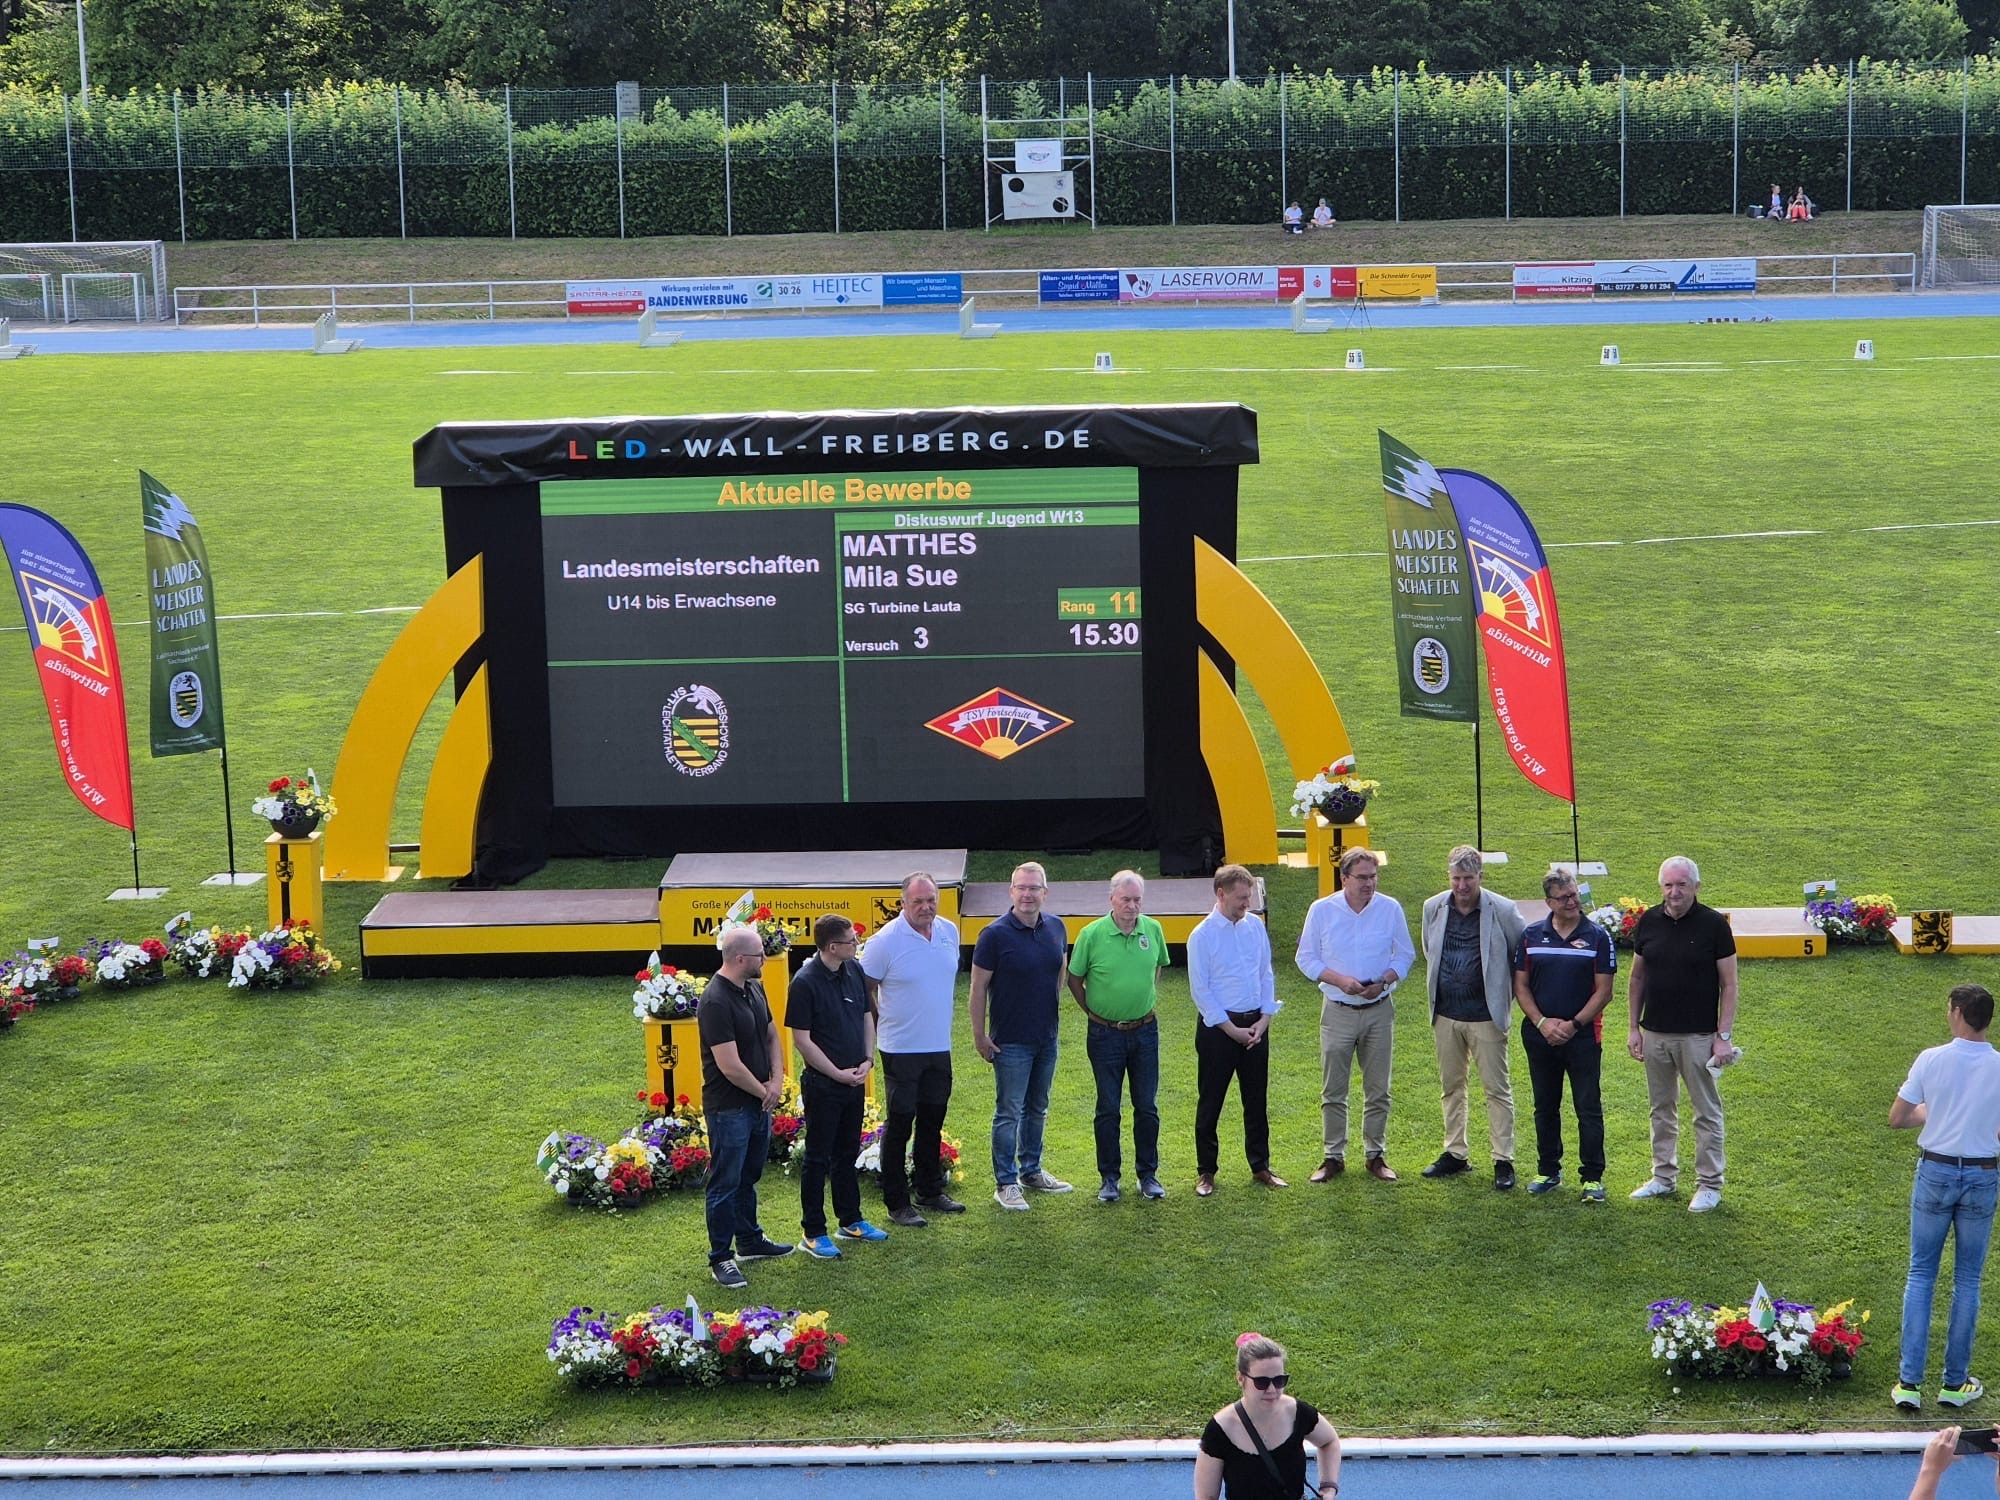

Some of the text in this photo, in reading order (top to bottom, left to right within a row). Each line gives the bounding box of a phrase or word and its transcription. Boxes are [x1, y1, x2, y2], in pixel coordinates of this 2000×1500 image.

[812, 277, 873, 293] HEITEC
[1161, 272, 1264, 286] LASERVORM
[1411, 272, 1432, 280] Gruppe
[1561, 276, 1593, 284] Kitzing
[661, 282, 734, 293] Wirkung erzielen mit
[778, 286, 801, 295] 30 26
[648, 293, 748, 307] BANDENWERBUNG
[717, 476, 972, 506] Aktuelle Bewerbe
[894, 510, 1084, 527] Diskuswurf Jugend W13
[843, 532, 977, 557] MATTHES
[1392, 528, 1457, 551] LANDES
[152, 559, 202, 588] LANDES
[562, 555, 820, 579] Landesmeisterschaften
[1395, 554, 1459, 574] MEISTER
[844, 564, 958, 588] Mila Sue
[1397, 577, 1460, 595] SCHAFTEN
[154, 585, 204, 611] MEISTER
[607, 592, 777, 611] U14 bis Erwachsene
[844, 600, 961, 614] SG Turbine Lauta
[1060, 591, 1136, 615] Rang 11
[156, 608, 206, 632] SCHAFTEN
[845, 626, 929, 652] Versuch 3
[1069, 622, 1139, 646] 15.30
[964, 707, 1031, 720] TSV Fortschritt
[662, 700, 729, 777] LEICHTATHLETIK-VERBAND SACHSEN
[692, 900, 721, 909] Große
[775, 900, 850, 910] Hochschulstadt
[1804, 939, 1814, 955] 5
